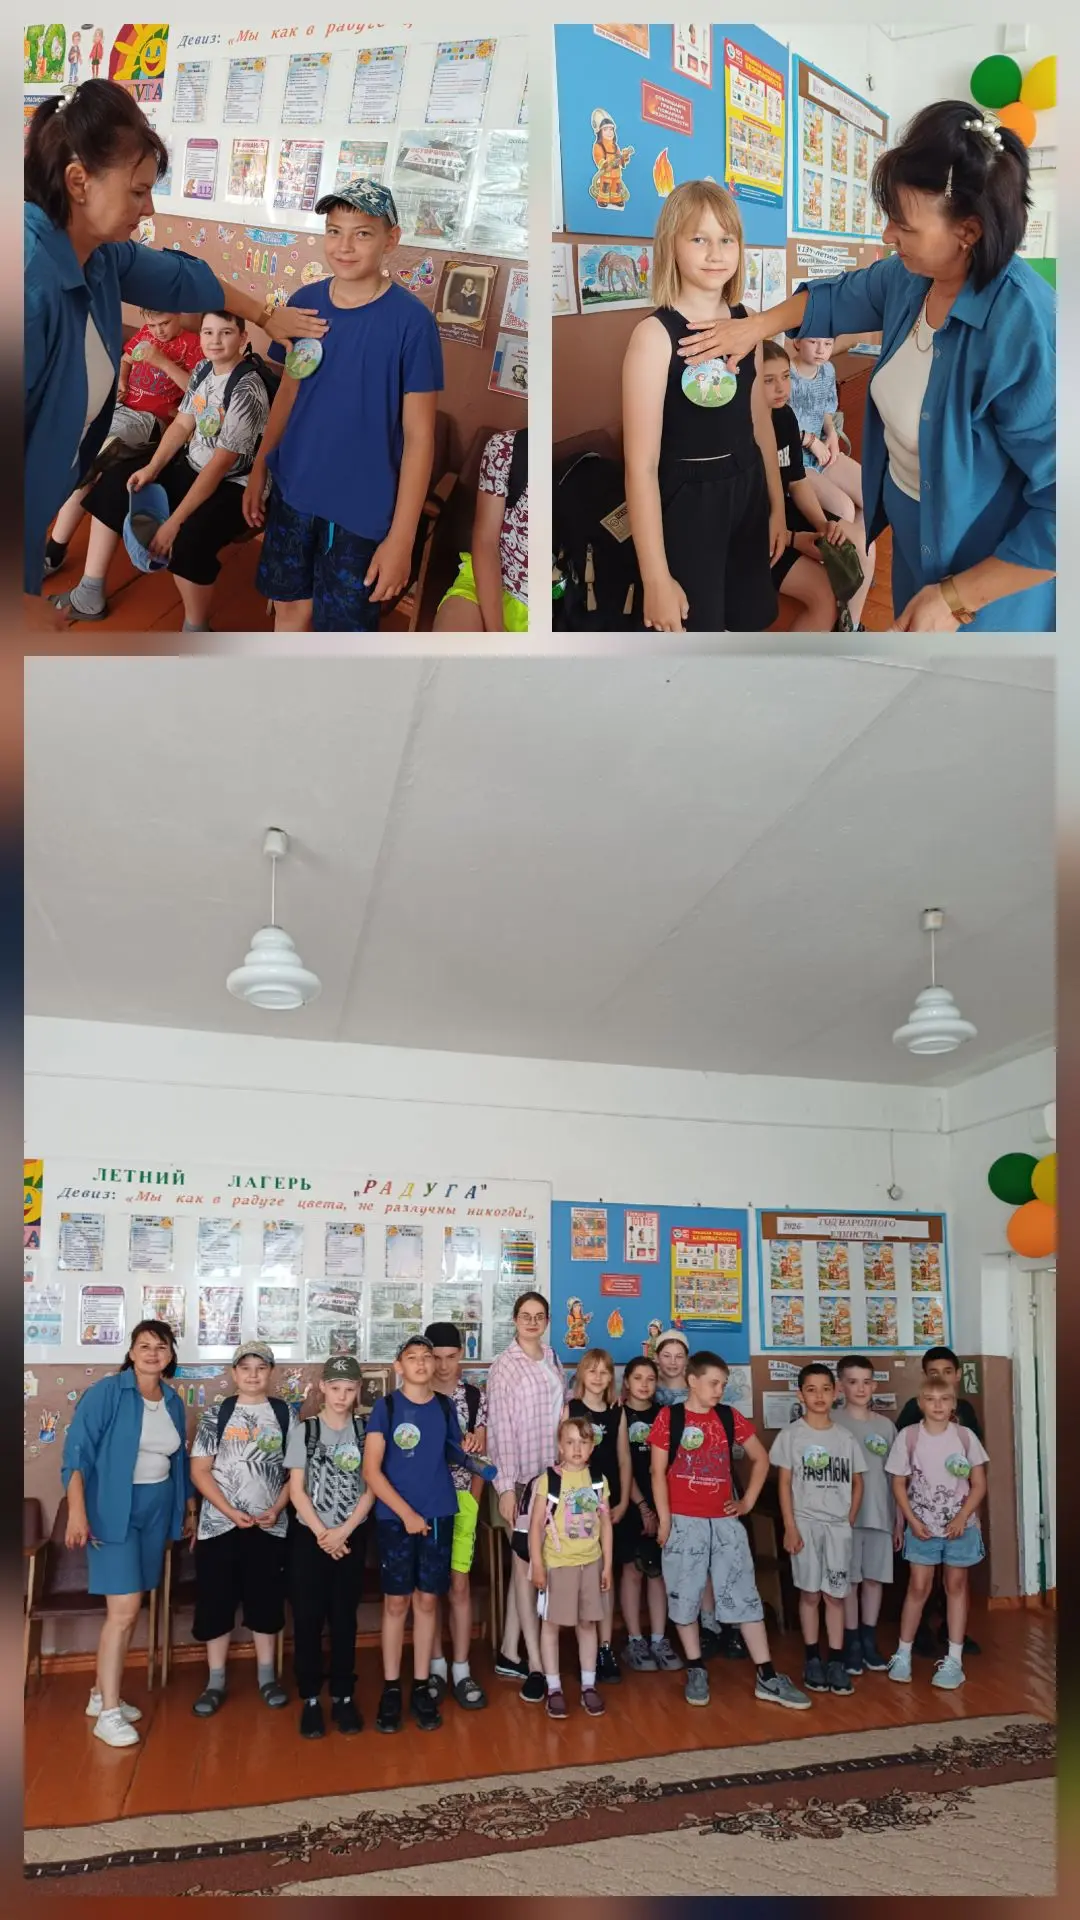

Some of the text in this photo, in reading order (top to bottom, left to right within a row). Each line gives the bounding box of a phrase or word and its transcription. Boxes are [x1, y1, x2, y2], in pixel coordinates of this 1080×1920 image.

[177, 33, 221, 49] Девиз:
[271, 27, 298, 40] как
[306, 24, 315, 36] в
[92, 1167, 185, 1186] ЛЕТНИЙ
[228, 1174, 312, 1191] ЛАГЕРЬ
[57, 1187, 117, 1200] Девиз:
[176, 1193, 203, 1204] как
[212, 1195, 221, 1204] в
[231, 1193, 285, 1209] радуге
[297, 1200, 347, 1212] цвета,
[358, 1201, 374, 1211] не
[384, 1203, 457, 1216] разлучны
